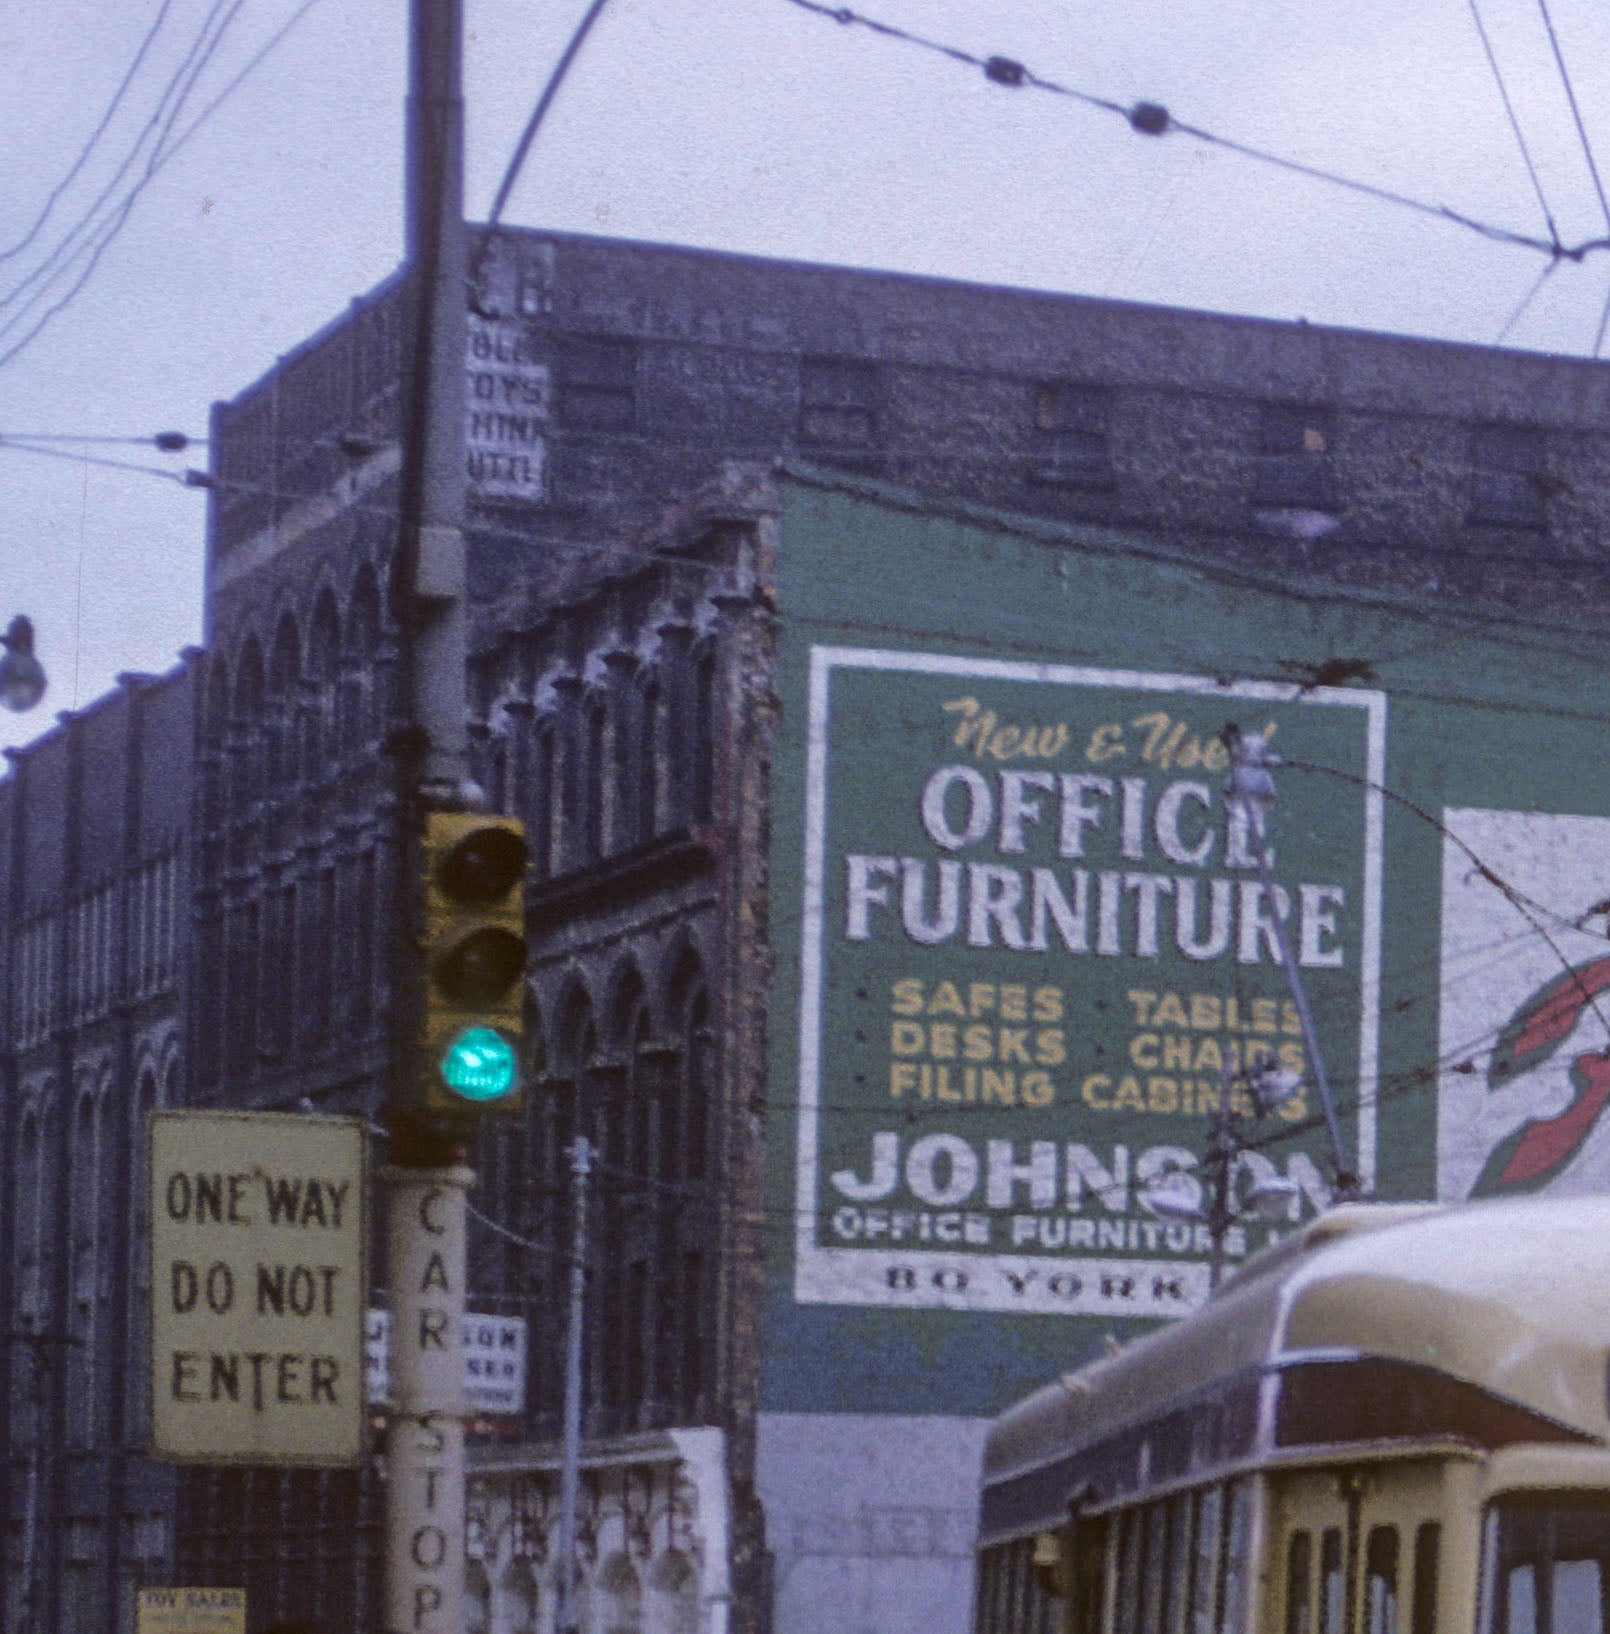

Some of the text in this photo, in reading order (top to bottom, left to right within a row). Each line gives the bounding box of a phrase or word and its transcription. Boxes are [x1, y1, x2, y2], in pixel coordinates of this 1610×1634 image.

[942, 696, 1278, 770] New & Use
[921, 764, 1276, 869] OFFICE
[846, 855, 1346, 968] FURNITURE
[891, 978, 1303, 1035] SAFES TABLES
[892, 1022, 1067, 1066] DESKS
[889, 1063, 1308, 1121] FILING CABINES
[166, 1173, 351, 1229] ONE WAY
[831, 1131, 1334, 1220] JOHNSON
[832, 1206, 989, 1244] OFFICE
[1011, 1214, 1247, 1256] FURNITURE
[170, 1260, 339, 1318] DO NOT
[418, 1191, 450, 1351] CAR
[1004, 1268, 1186, 1301] YORK
[170, 1352, 341, 1408] ENTER
[412, 1412, 448, 1632] STOP
